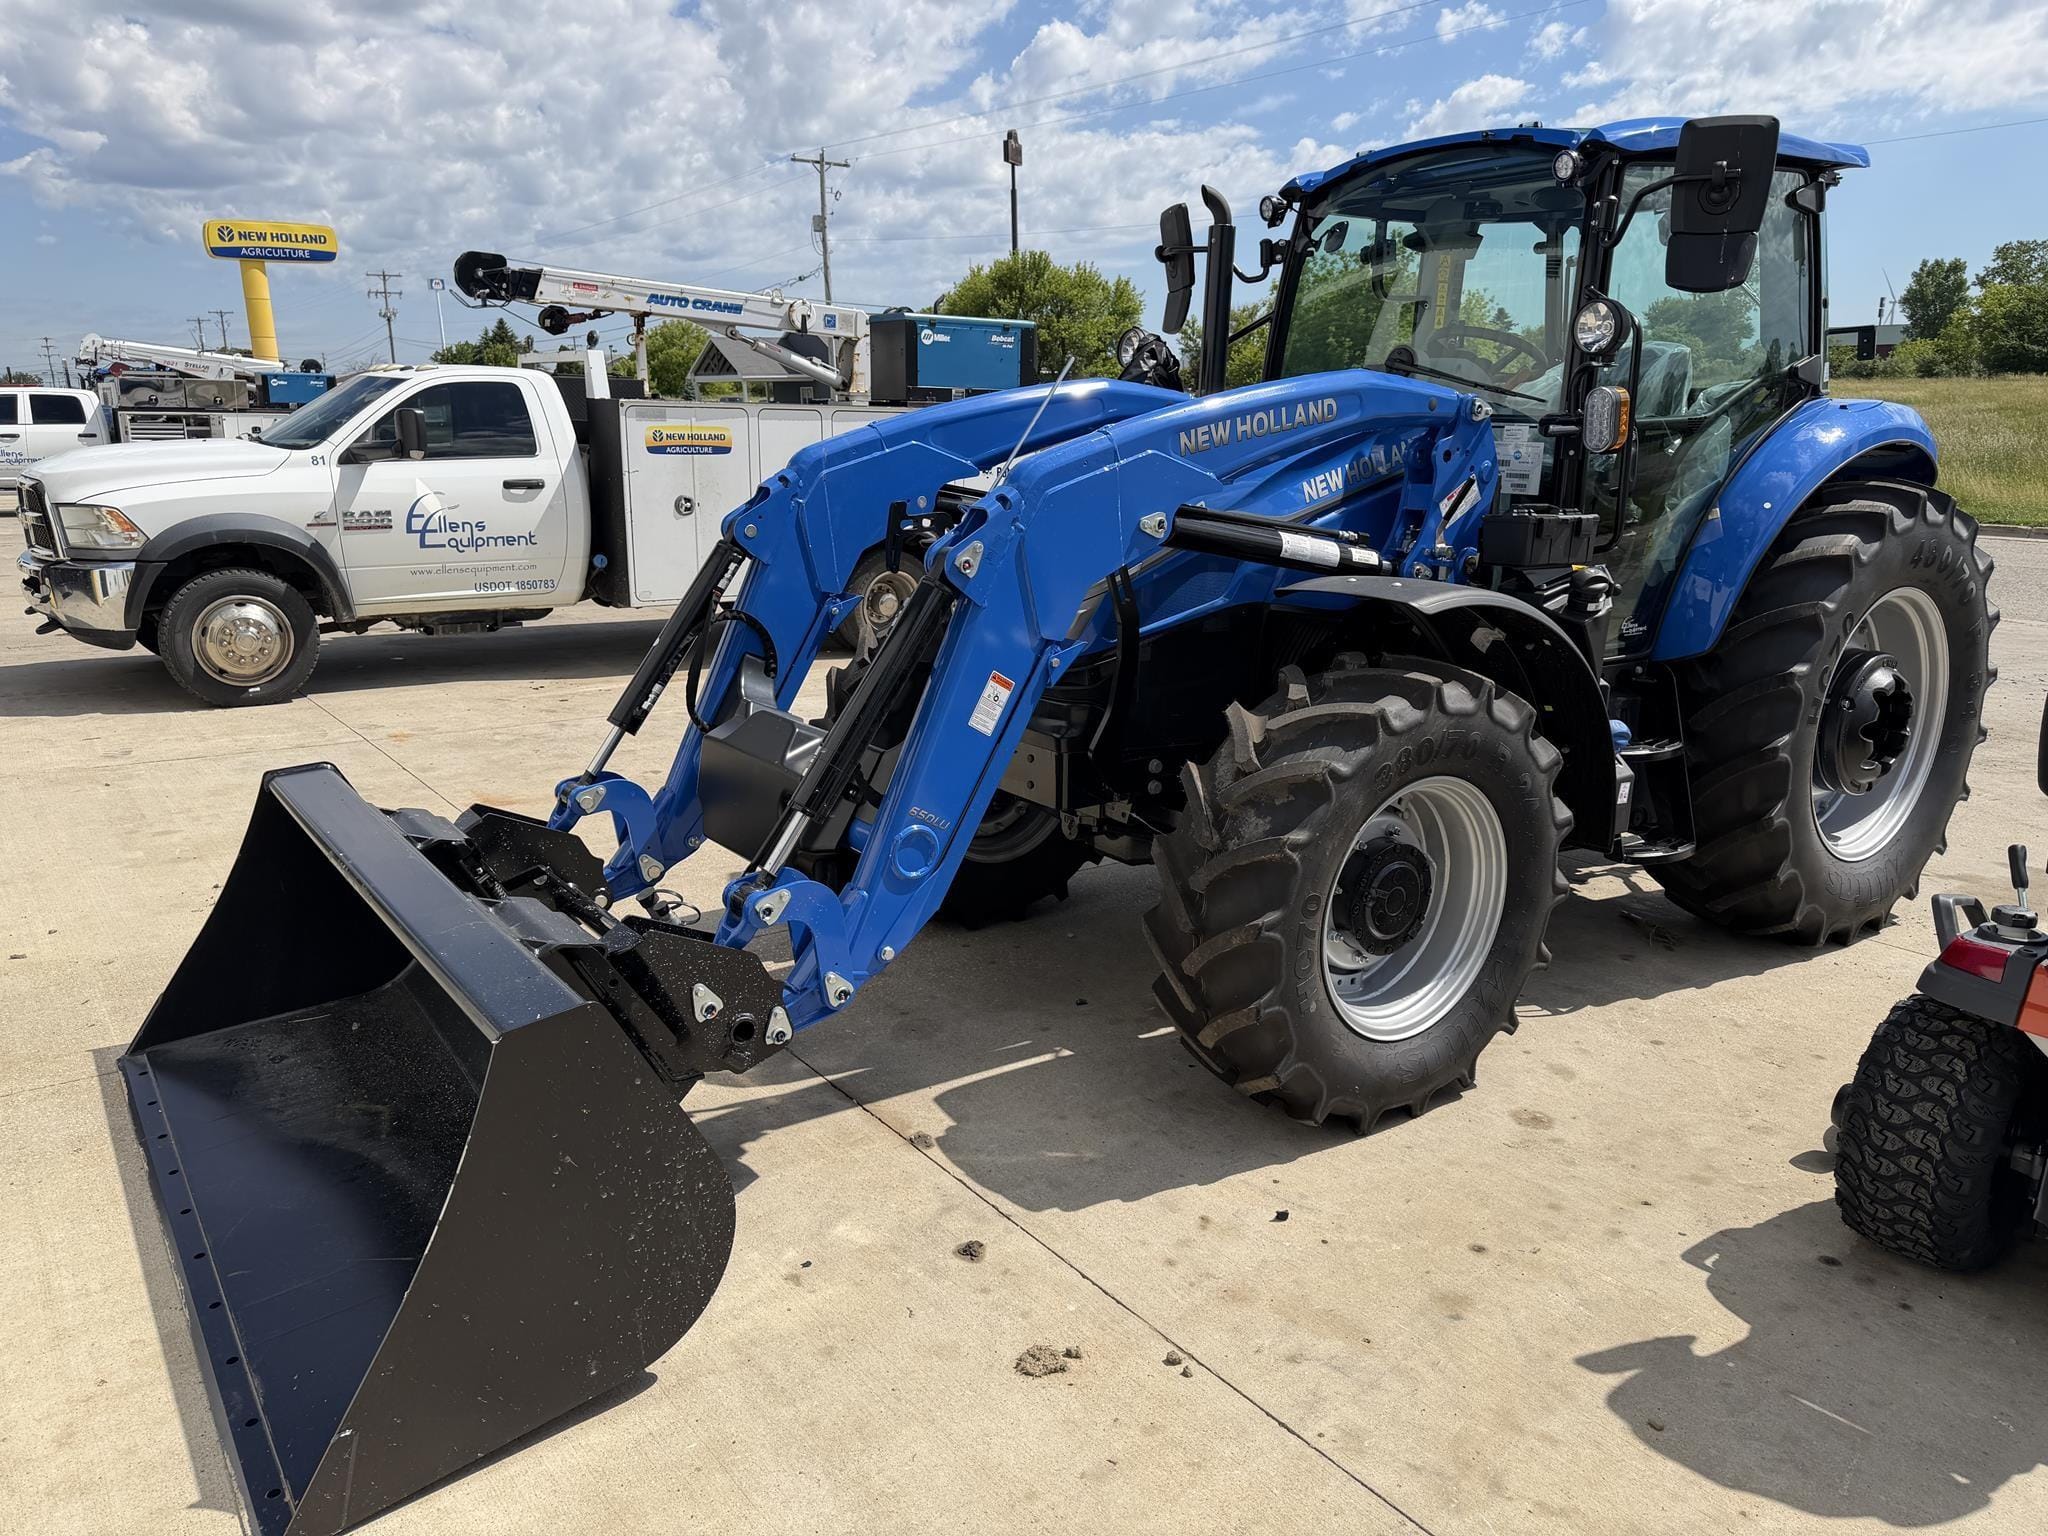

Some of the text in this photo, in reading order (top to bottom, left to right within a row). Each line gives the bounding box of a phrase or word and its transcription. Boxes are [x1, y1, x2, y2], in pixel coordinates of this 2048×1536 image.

[237, 230, 328, 245] NEW HOLLAND
[240, 247, 310, 258] AGRICULTURE
[646, 293, 744, 315] AUTO CRANE
[991, 335, 1015, 343] Bobcat
[1179, 398, 1338, 456] NEW HOLLAND
[665, 432, 726, 441] NEW HOLLAND
[0, 449, 23, 460] llens
[666, 446, 713, 454] AGRICULTURE
[311, 455, 326, 466] 81
[1302, 467, 1343, 503] NEW
[342, 510, 392, 518] RAM
[406, 493, 486, 534] Ellens
[420, 508, 538, 553] Equipment
[410, 563, 537, 576] www.ellensequipment.com
[474, 579, 556, 592] USDOT 1850783
[908, 805, 951, 831] 650LU
